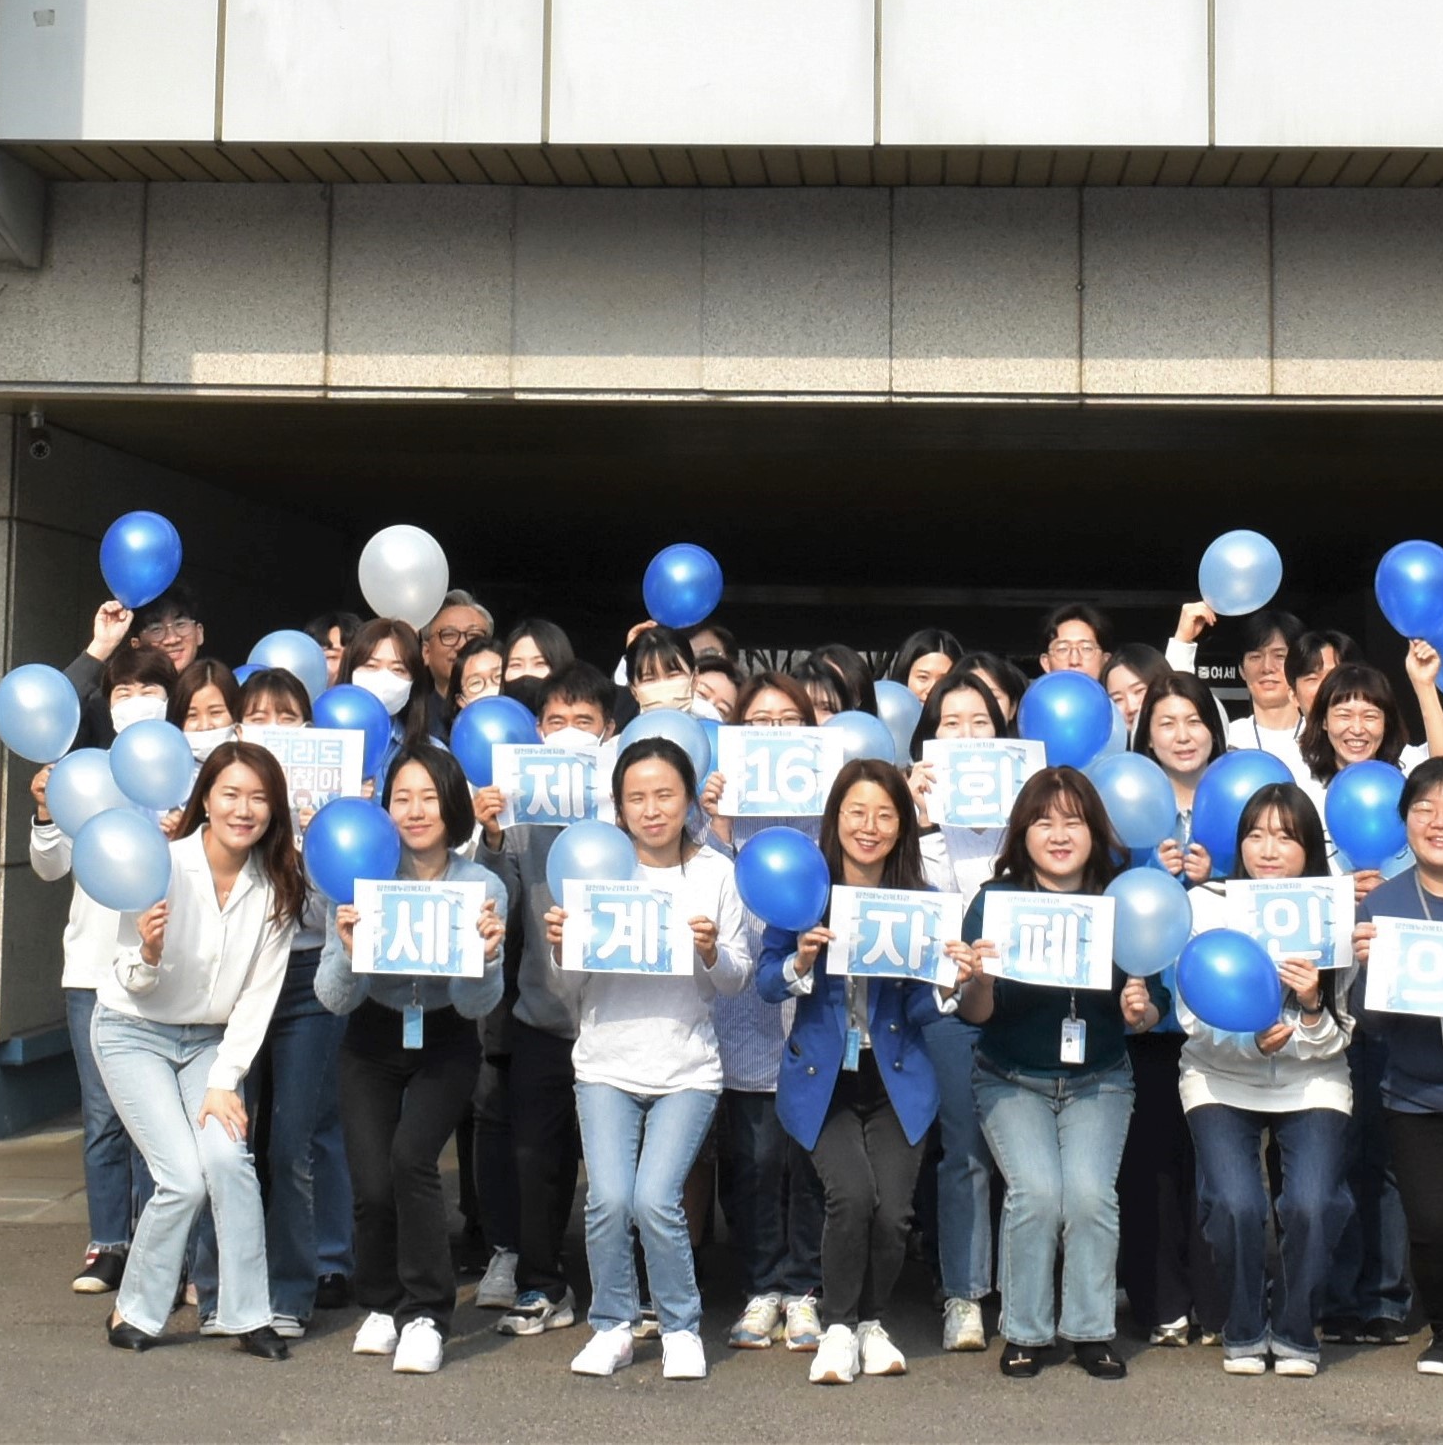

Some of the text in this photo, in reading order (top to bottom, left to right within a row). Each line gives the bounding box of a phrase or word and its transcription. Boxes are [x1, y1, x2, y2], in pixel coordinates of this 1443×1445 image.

[524, 762, 585, 819] 제
[745, 746, 818, 804] 16
[955, 754, 1014, 818] 회
[386, 900, 450, 965] 세
[596, 900, 659, 965] 계
[861, 909, 931, 970] 자
[1262, 896, 1323, 962] 인
